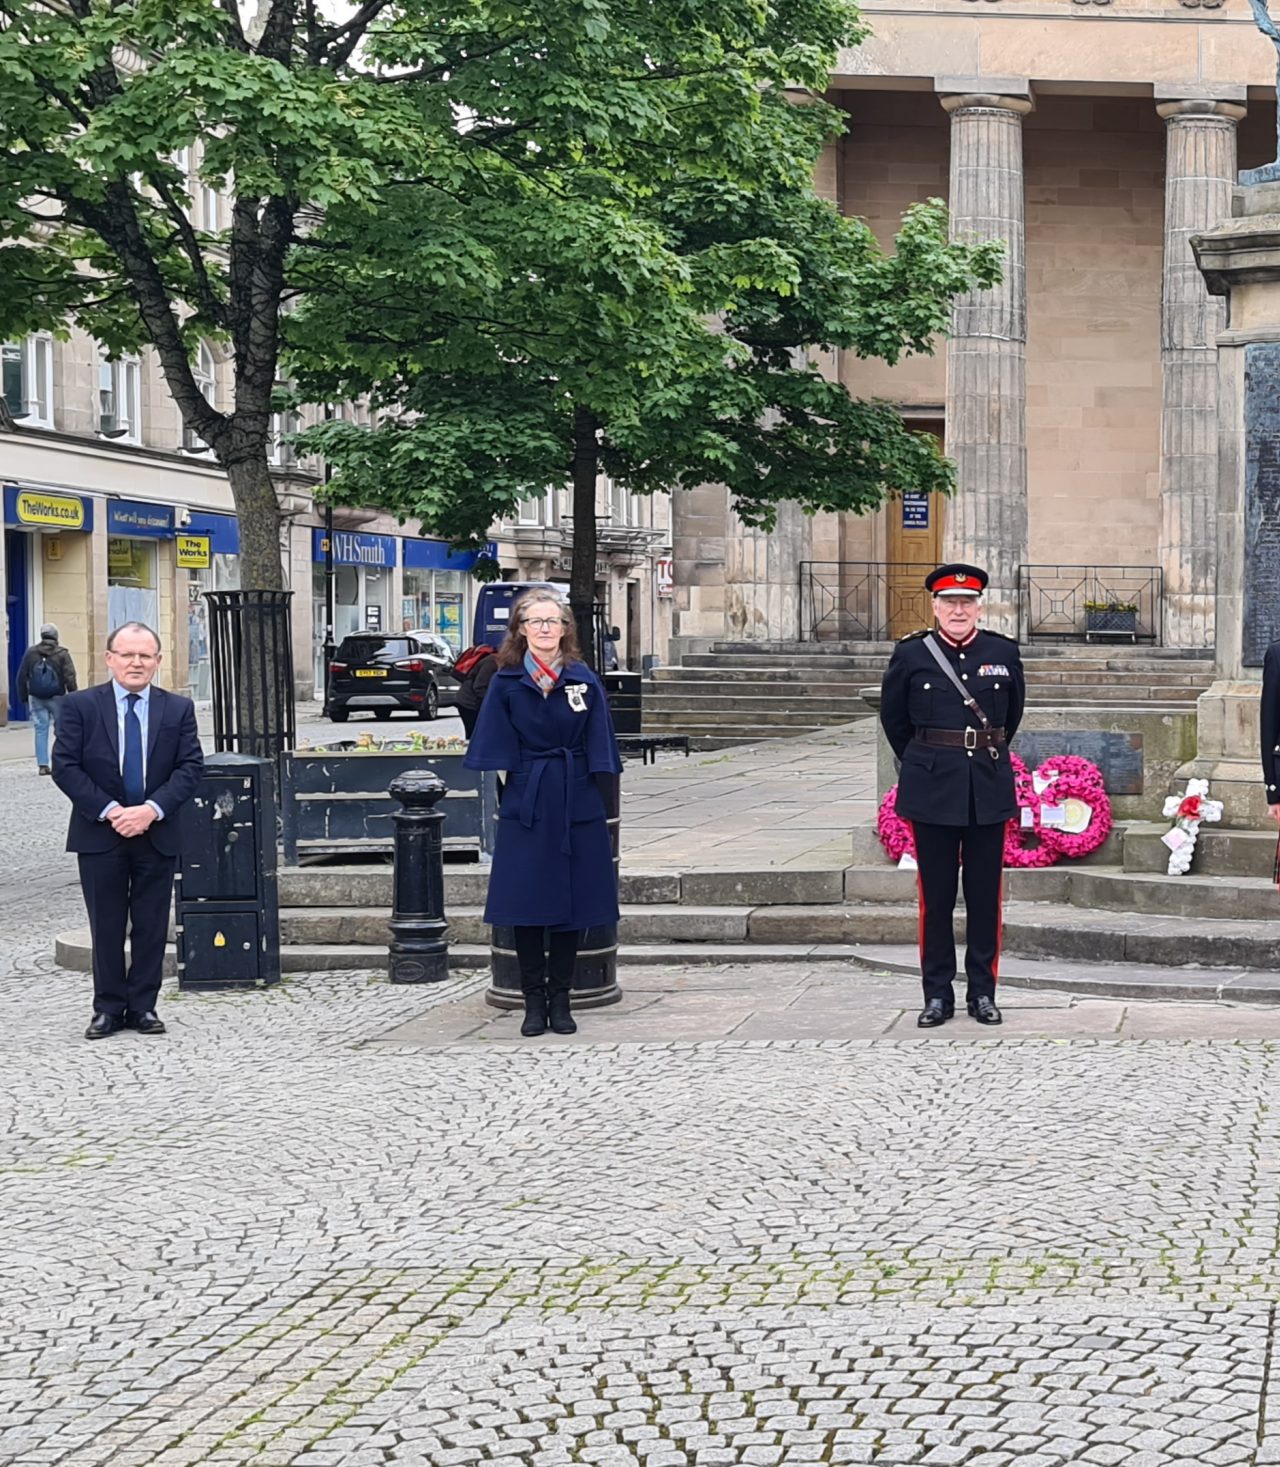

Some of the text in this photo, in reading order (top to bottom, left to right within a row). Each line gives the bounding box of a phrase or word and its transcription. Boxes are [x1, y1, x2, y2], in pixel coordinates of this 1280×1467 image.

[22, 499, 80, 520] TheWorks.co.uk
[185, 540, 201, 548] The
[179, 548, 208, 557] Works
